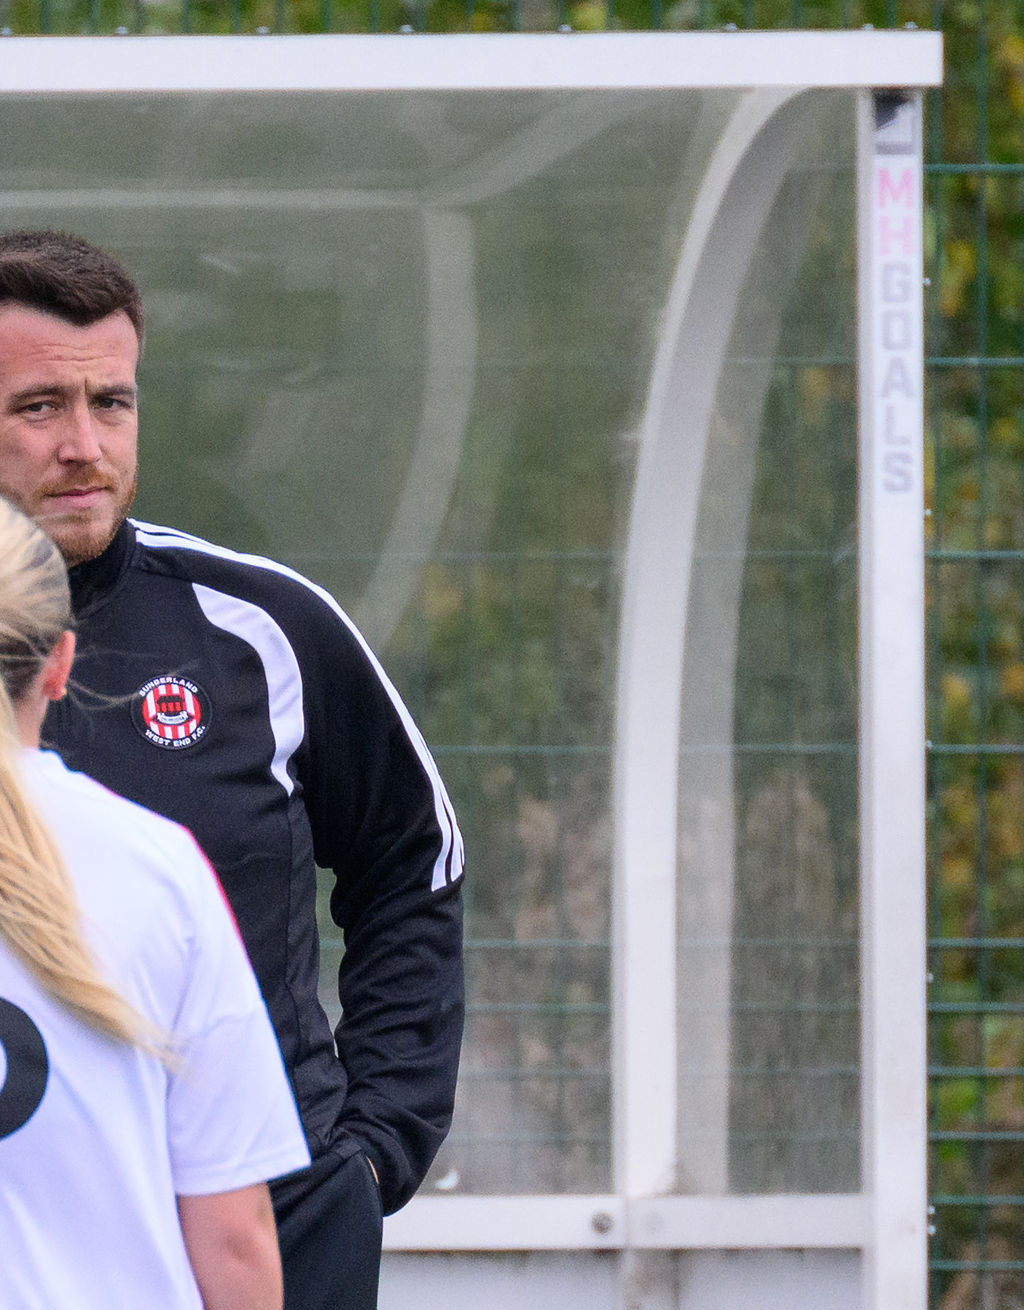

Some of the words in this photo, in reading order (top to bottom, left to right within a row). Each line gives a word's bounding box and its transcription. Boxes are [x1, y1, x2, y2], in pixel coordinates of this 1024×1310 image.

[881, 261, 915, 492] GOALS
[139, 676, 198, 697] SUNDERLAND
[145, 729, 171, 746] WEST
[173, 737, 191, 747] END
